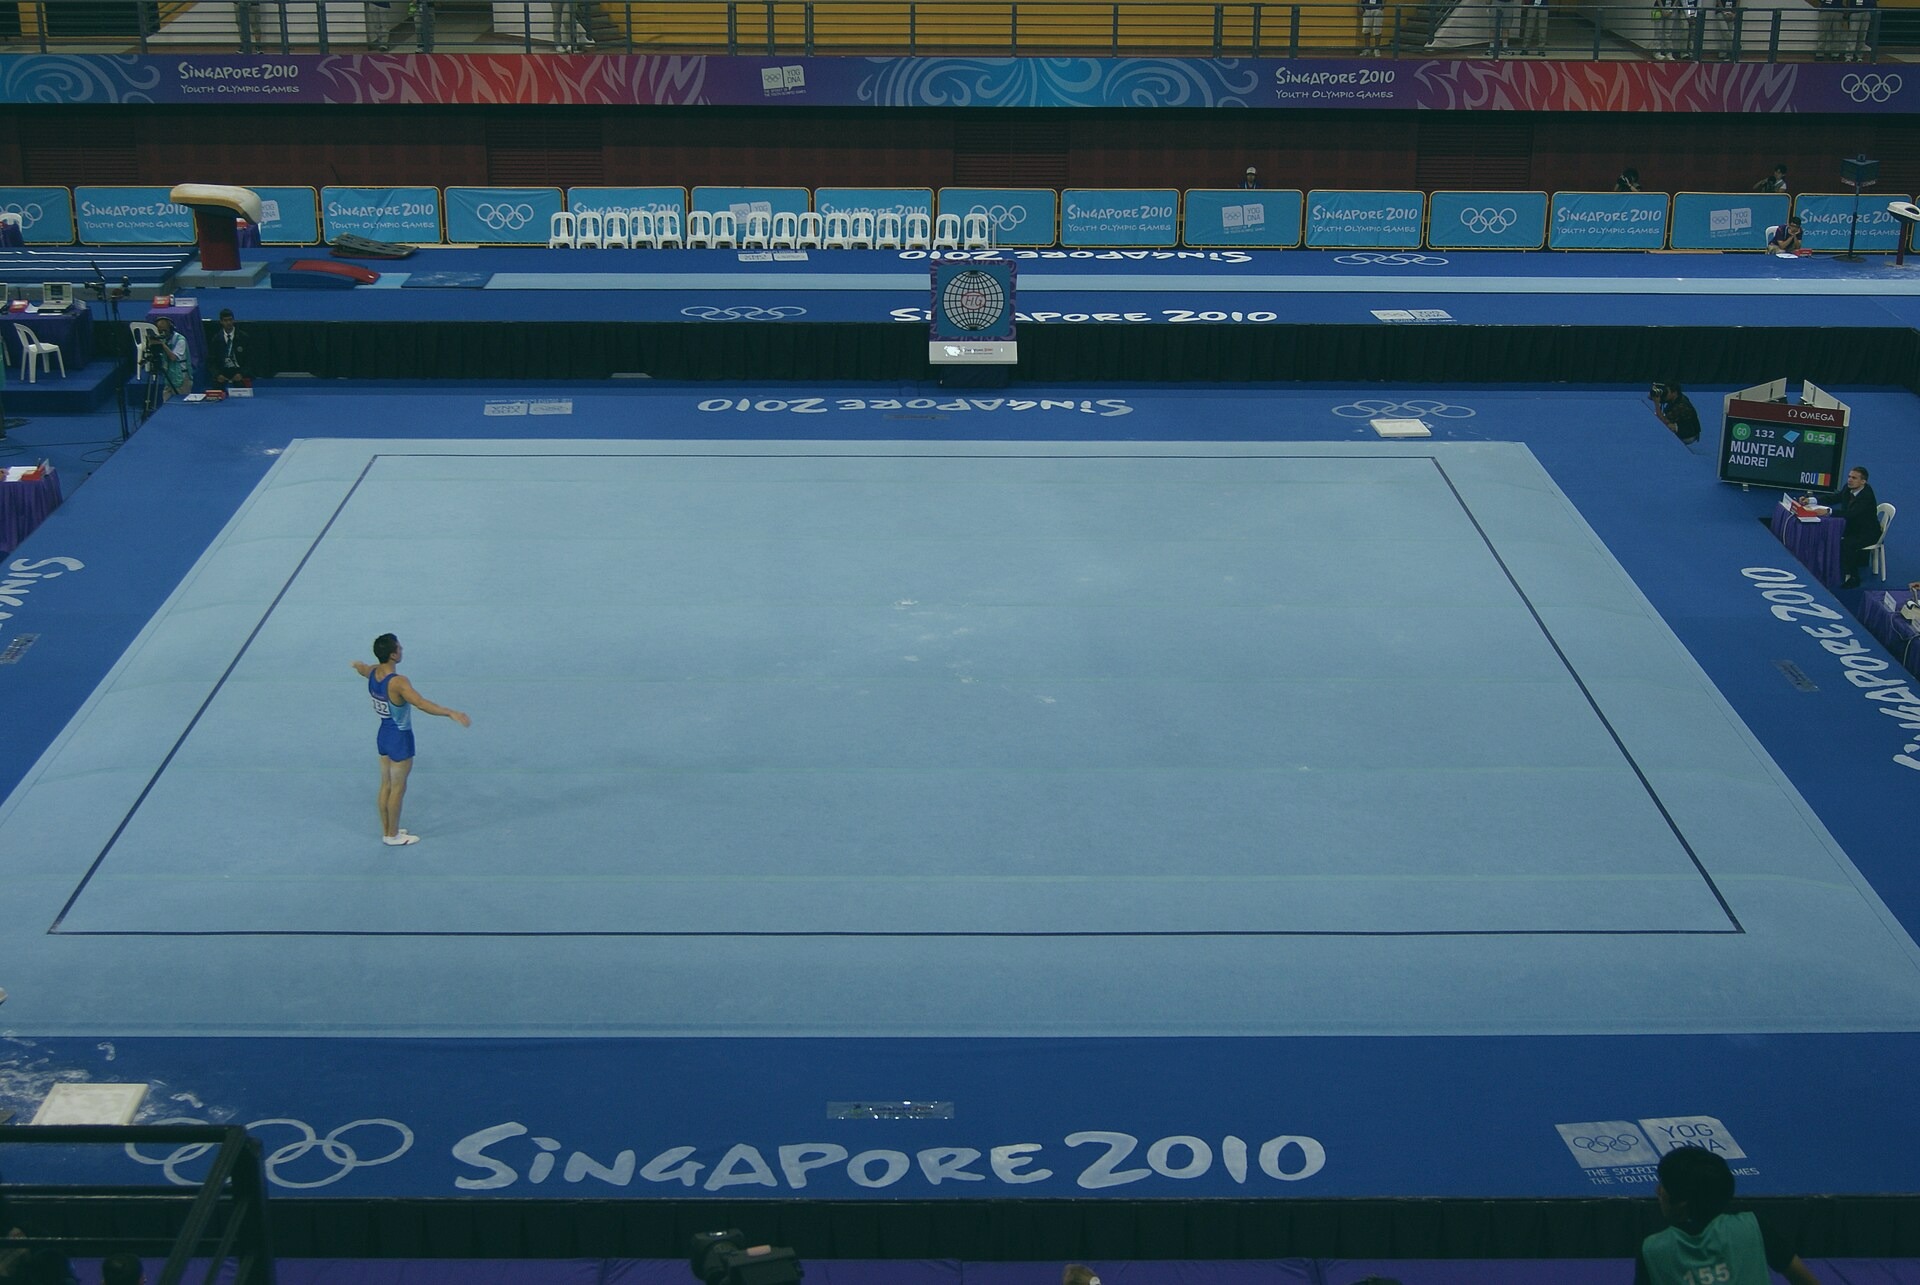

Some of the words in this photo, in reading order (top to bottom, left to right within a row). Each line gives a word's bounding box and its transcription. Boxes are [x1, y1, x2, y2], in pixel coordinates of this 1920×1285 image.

[261, 64, 299, 79] 2010
[1359, 69, 1396, 84] 2010
[217, 85, 261, 93] OLYMPIC
[262, 85, 300, 94] GAMES
[1311, 90, 1355, 99] OLYMPIC
[1356, 90, 1394, 99] GAMES
[157, 203, 188, 216] 2010
[402, 203, 434, 216] 2010
[1141, 205, 1173, 219] 2010
[1386, 207, 1418, 220] 2010
[1630, 208, 1662, 222] 2010
[117, 221, 156, 229] OLYMPIC
[157, 221, 189, 229] GAMES
[362, 221, 400, 229] OLYMPIC
[401, 221, 434, 229] GAMES
[1099, 224, 1137, 232] OLYMPIC
[1344, 225, 1382, 233] OLYMPIC
[1384, 225, 1416, 233] GAMES
[1588, 226, 1625, 234] OLYMPIC
[1627, 226, 1660, 234] GAMES
[899, 250, 1003, 260] 2010
[1162, 309, 1278, 322] 2010
[697, 398, 828, 413] 2010
[1800, 411, 1835, 421] OMEGA
[1736, 427, 1747, 436] GO
[1755, 429, 1775, 439] 132
[1806, 432, 1833, 443] 0:54
[1730, 441, 1795, 459] MUNTEAN
[1728, 454, 1768, 468] ANDREI
[1800, 471, 1816, 484] ROU
[1740, 567, 1843, 622] 2010
[1658, 1123, 1714, 1139] YOG
[1063, 1131, 1327, 1189] 2010
[1584, 1168, 1609, 1177] THE
[1590, 1177, 1615, 1185] THE
[1616, 1174, 1659, 1184] YOUTH
